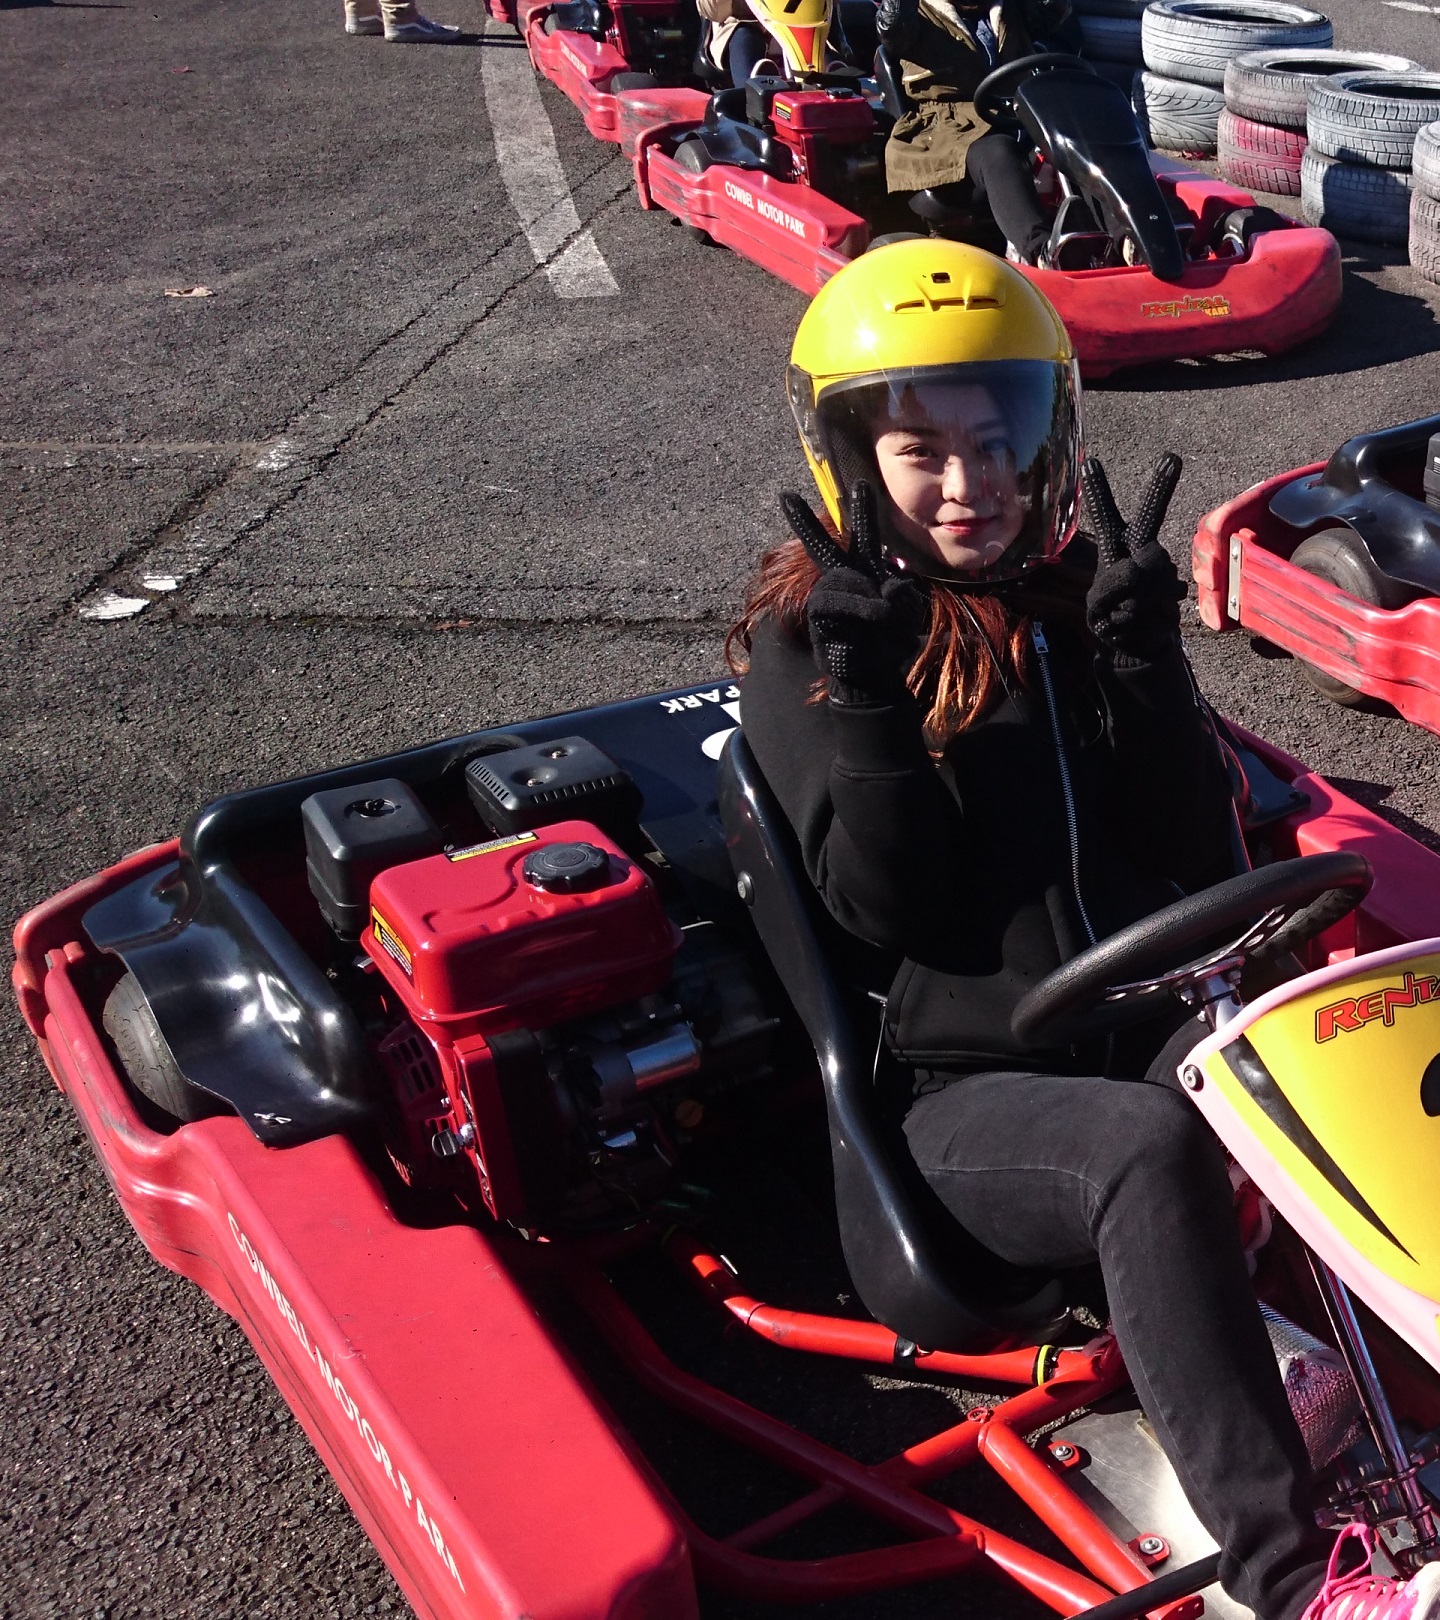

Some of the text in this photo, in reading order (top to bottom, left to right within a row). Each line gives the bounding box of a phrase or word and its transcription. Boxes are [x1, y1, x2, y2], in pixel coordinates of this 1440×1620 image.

[757, 199, 786, 225] MOTOR
[784, 213, 806, 238] PARK
[1141, 295, 1230, 318] RENTAL
[1203, 305, 1230, 317] KART
[660, 685, 741, 714] PARK
[227, 1212, 316, 1363] COWBELL
[315, 1346, 398, 1490] MOTOR
